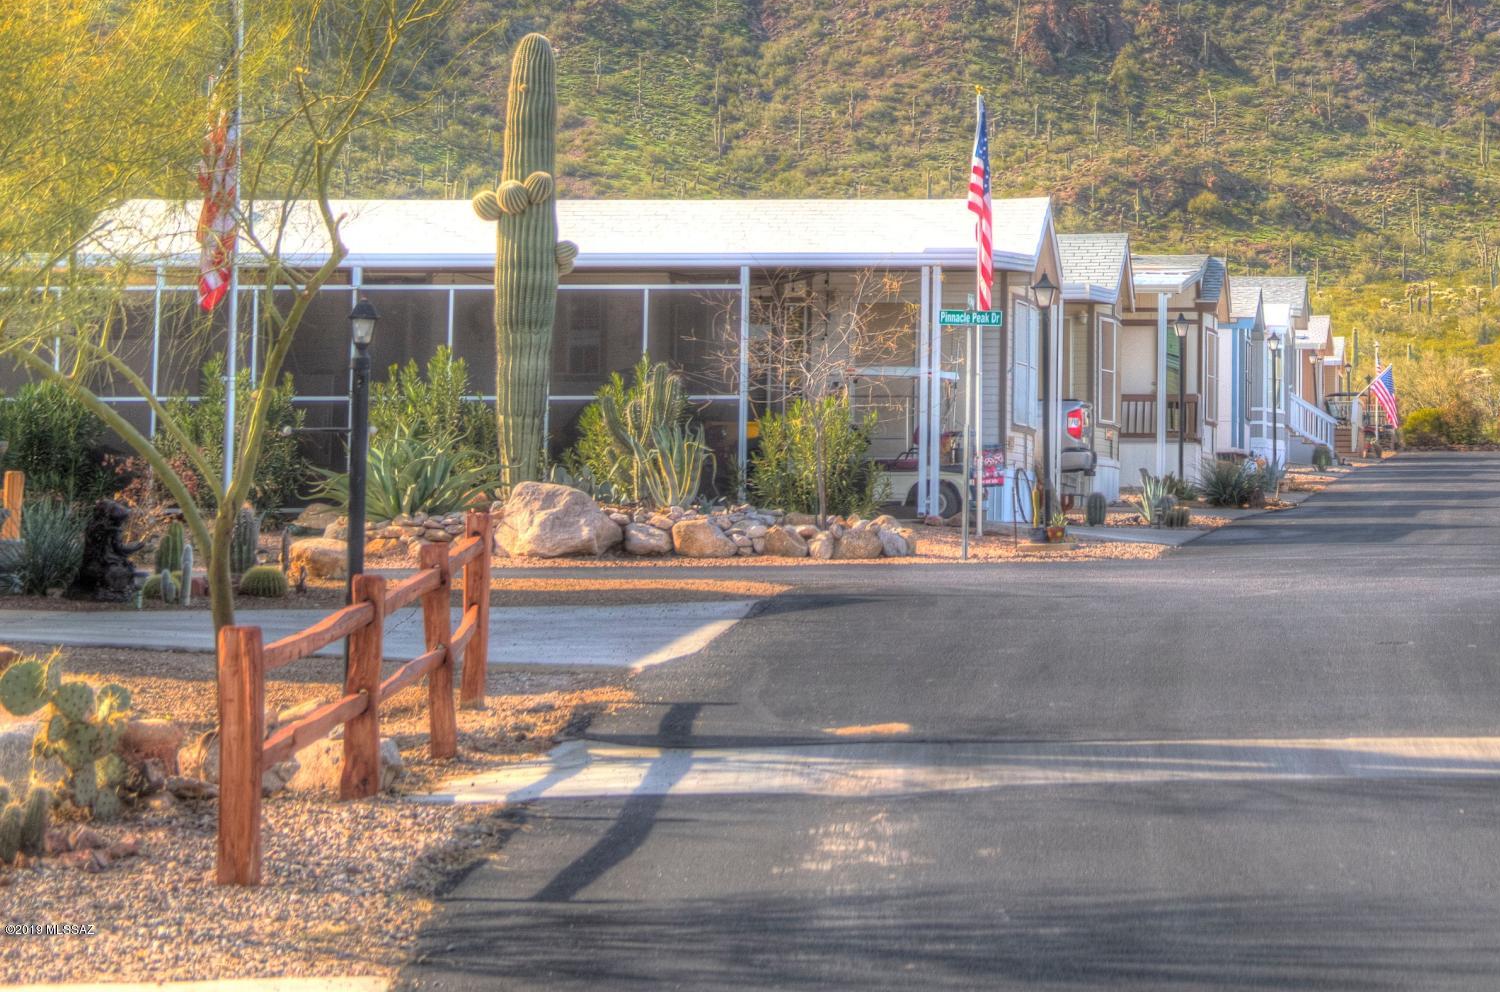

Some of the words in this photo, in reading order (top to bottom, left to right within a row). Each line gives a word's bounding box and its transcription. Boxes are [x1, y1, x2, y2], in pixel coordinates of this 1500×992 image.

[940, 311, 971, 323] Pinnacle
[972, 313, 989, 323] Peak
[991, 314, 1000, 324] Dr
